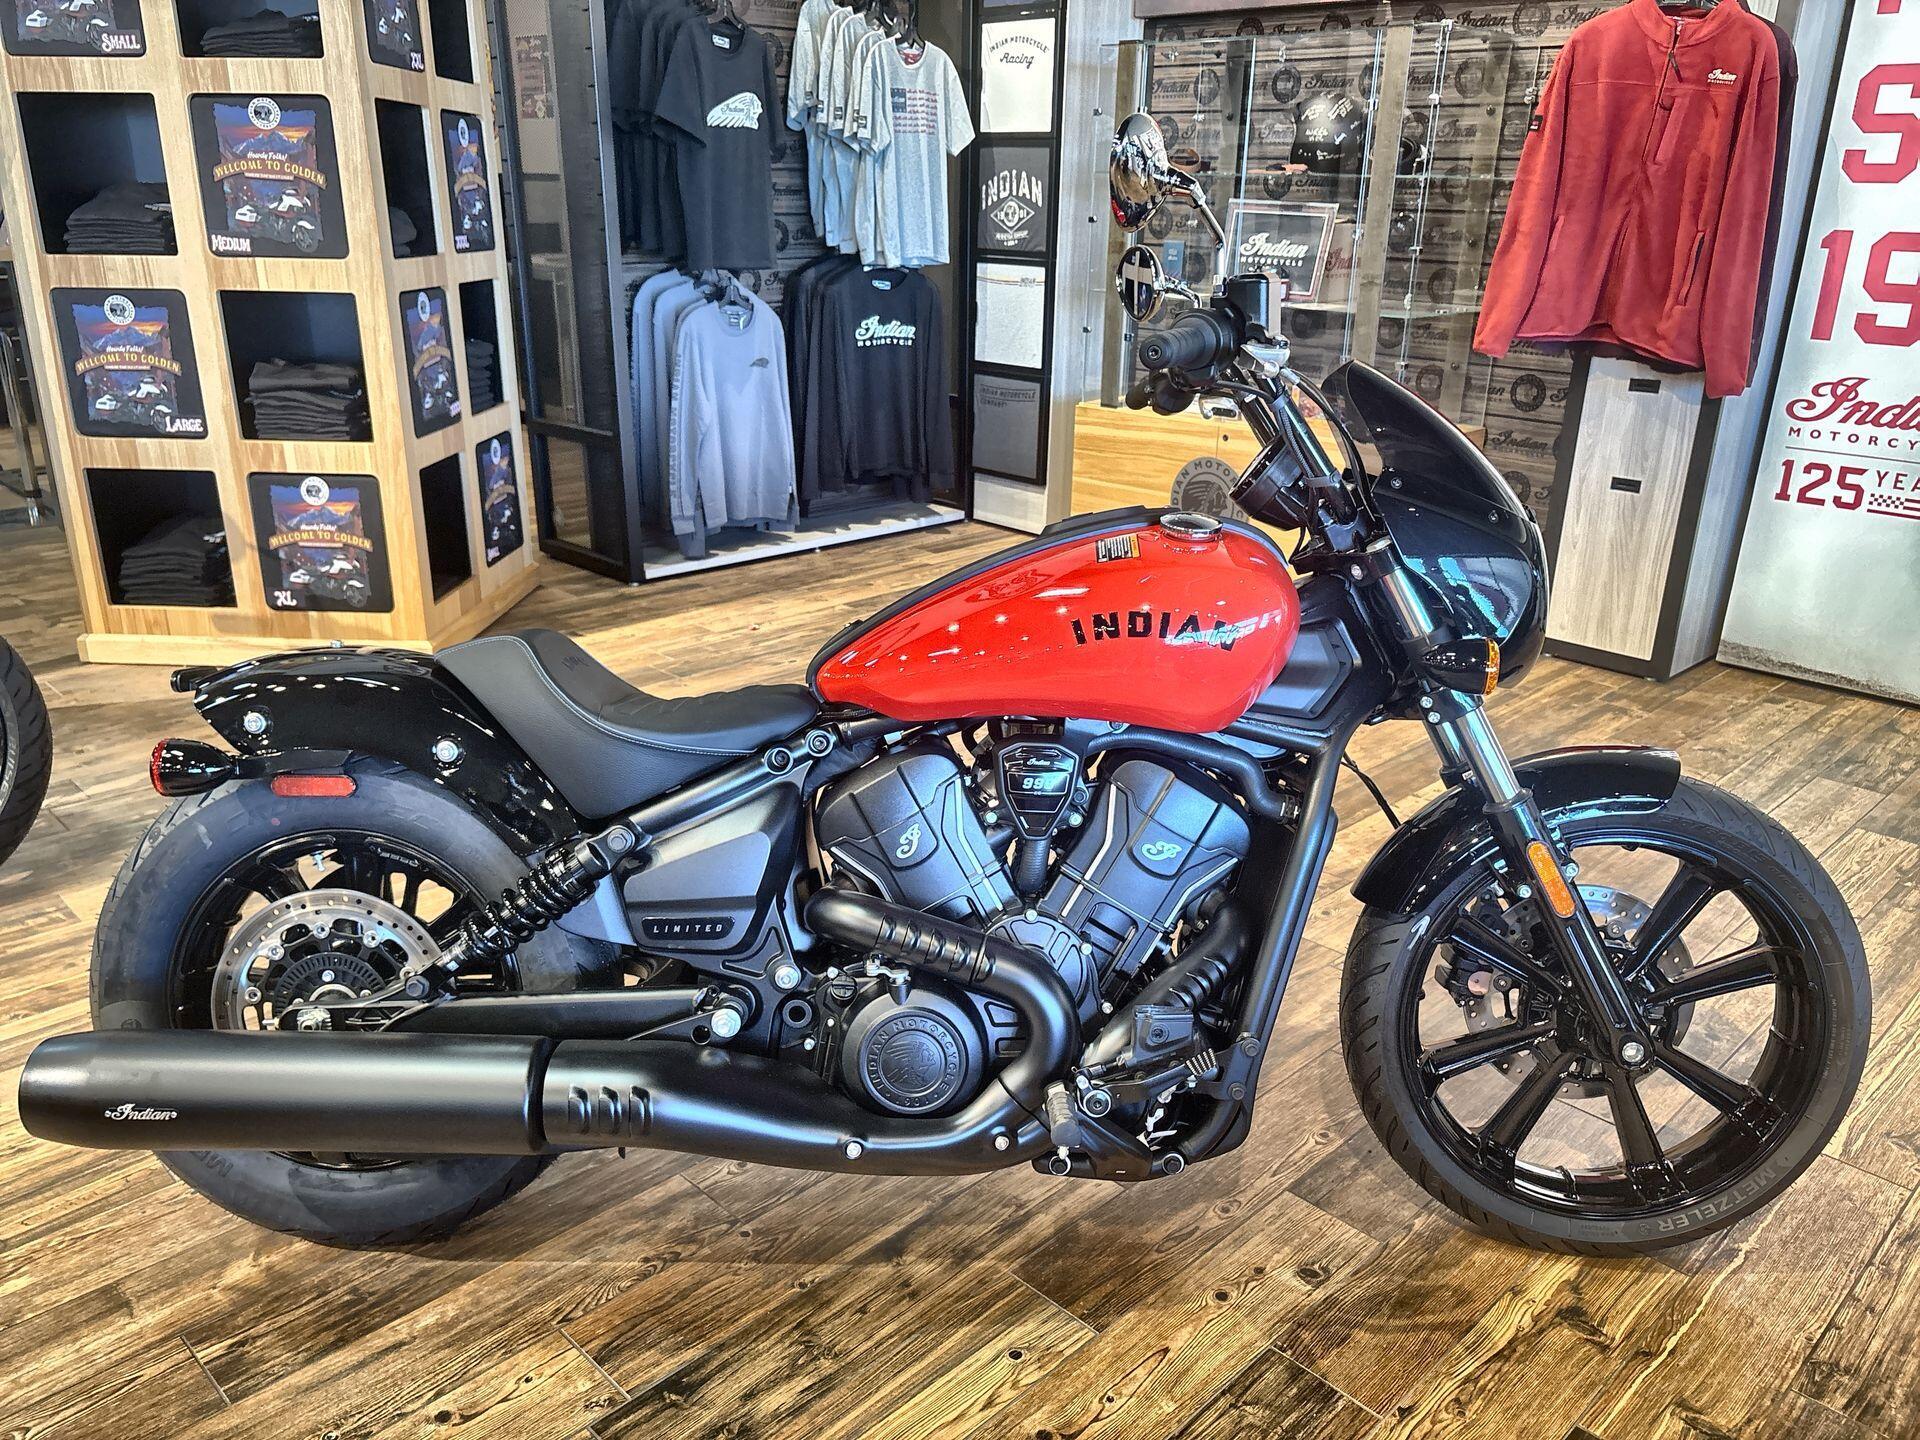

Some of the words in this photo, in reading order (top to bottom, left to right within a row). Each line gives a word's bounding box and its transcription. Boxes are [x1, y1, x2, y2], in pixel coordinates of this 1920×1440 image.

[1456, 10, 1508, 28] Indian
[101, 33, 141, 52] SMALL
[989, 38, 1009, 53] INDIAN
[1010, 35, 1048, 54] MOTORCYCLE
[1000, 52, 1035, 70] Racing
[1304, 73, 1355, 90] Indian
[1708, 68, 1738, 81] Indian
[720, 102, 746, 116] Indian
[214, 160, 263, 177] WELCOME
[265, 160, 280, 171] TO
[284, 162, 325, 185] GOLDEN
[982, 168, 1043, 211] INDIAN
[210, 234, 252, 252] MEDIUM
[1240, 232, 1310, 259] Indian
[1240, 256, 1305, 268] MOTORCYCLE
[855, 315, 916, 340] Indian
[76, 354, 120, 372] WELCOME
[123, 353, 138, 362] TO
[141, 353, 180, 372] GOLDEN
[1785, 377, 1920, 433] Indi
[165, 415, 204, 433] LARGE
[1774, 458, 1870, 511] 125
[270, 531, 314, 546] WELCOME
[317, 531, 331, 540] TO
[334, 532, 370, 549] GOLDEN
[273, 590, 298, 607] XL
[1071, 611, 1242, 652] INDIAN
[1026, 758, 1051, 766] Indian
[653, 924, 723, 934] LIMITED
[868, 1029, 890, 1090] INDIAN
[892, 1018, 958, 1091] MOTORCYCLE
[111, 1103, 171, 1121] Indian
[1656, 1167, 1777, 1232] METZELER
